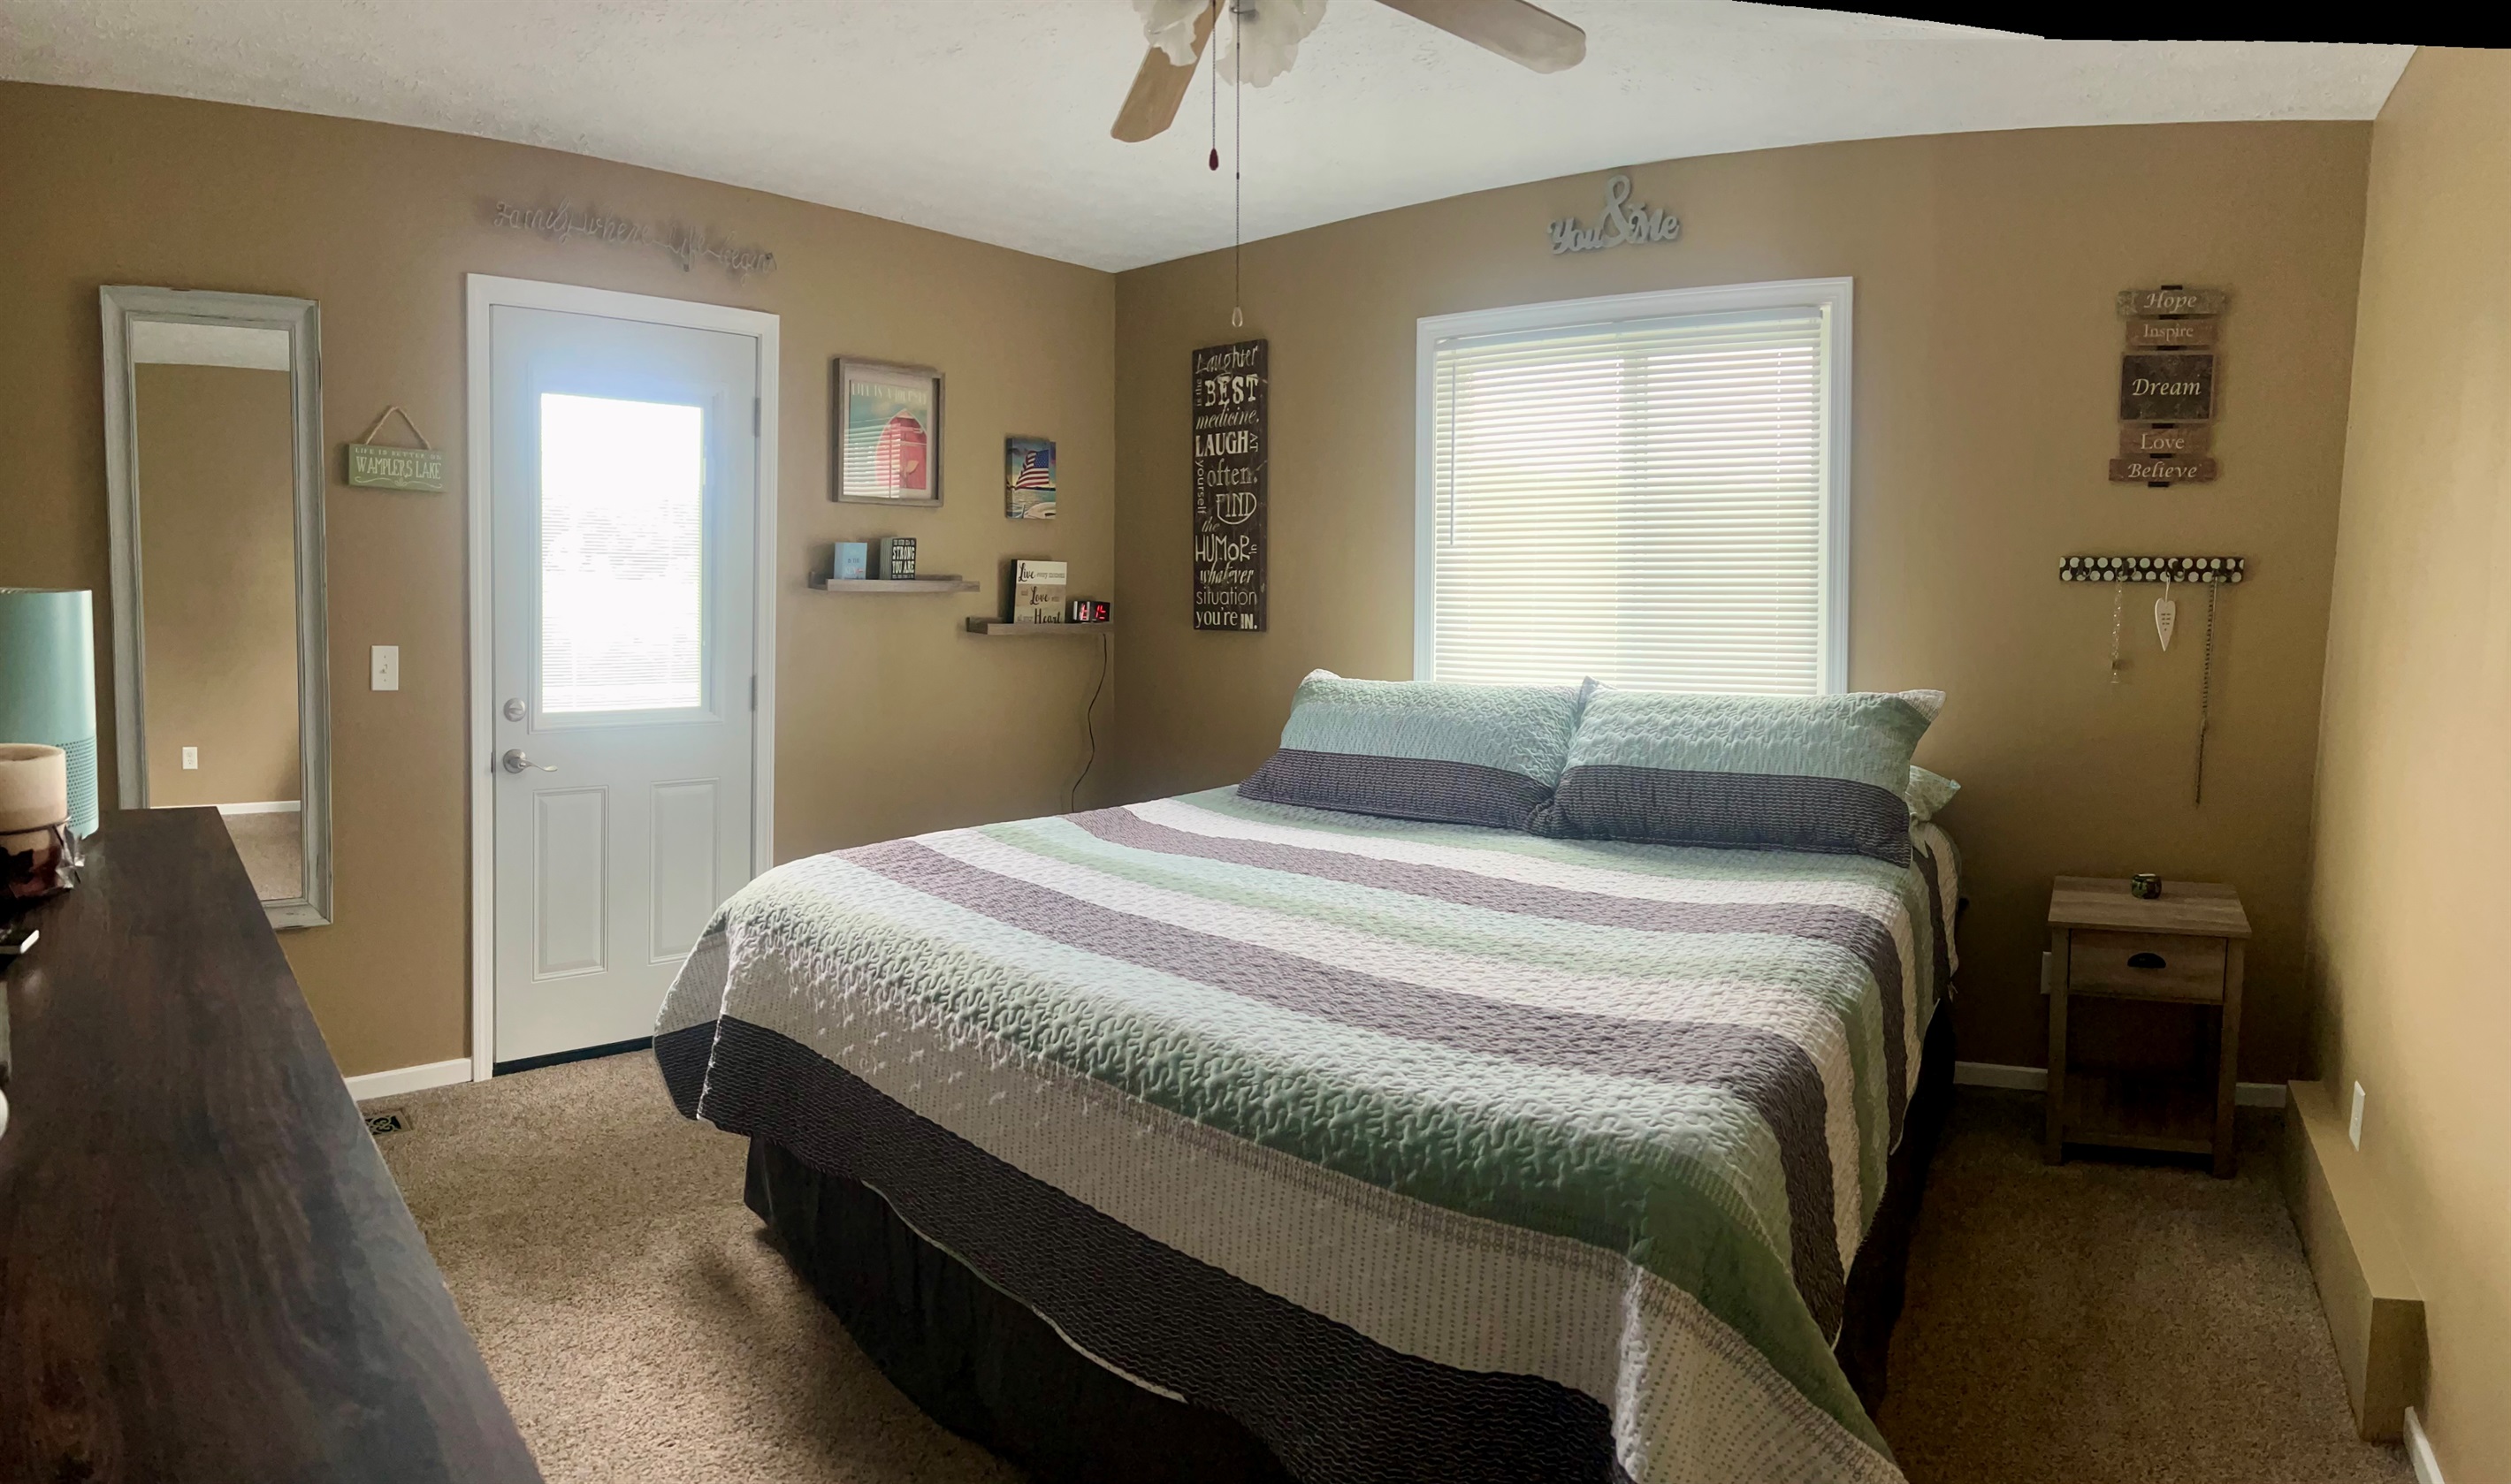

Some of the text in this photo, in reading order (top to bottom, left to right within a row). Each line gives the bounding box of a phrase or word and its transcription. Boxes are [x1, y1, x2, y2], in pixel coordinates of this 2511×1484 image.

[1547, 174, 1680, 255] You & Me
[2143, 292, 2197, 314] Hope
[2143, 323, 2194, 342] Inspire
[1195, 345, 1258, 375] Laughter
[1204, 373, 1259, 407] BEST
[2132, 378, 2202, 396] Dream
[1195, 403, 1260, 430] medicine.
[1195, 430, 1249, 458] LAUGH
[1249, 432, 1259, 453] AT
[2141, 432, 2186, 450] Love
[355, 456, 442, 480] WAMPLERS LAKE
[1207, 458, 1258, 487] often.
[2127, 460, 2198, 479] Believe
[1195, 460, 1207, 514] yourself
[1216, 492, 1257, 525] FIND
[1202, 515, 1220, 533] the
[892, 546, 915, 560] STRONG
[1248, 543, 1258, 555] in
[892, 560, 915, 574] YOU ARE
[1018, 562, 1035, 582] Live
[1200, 560, 1255, 584] whatever
[1030, 585, 1049, 605] Love
[1195, 586, 1257, 605] situation
[1034, 608, 1061, 625] Heart
[1195, 606, 1258, 629] you're IN.
